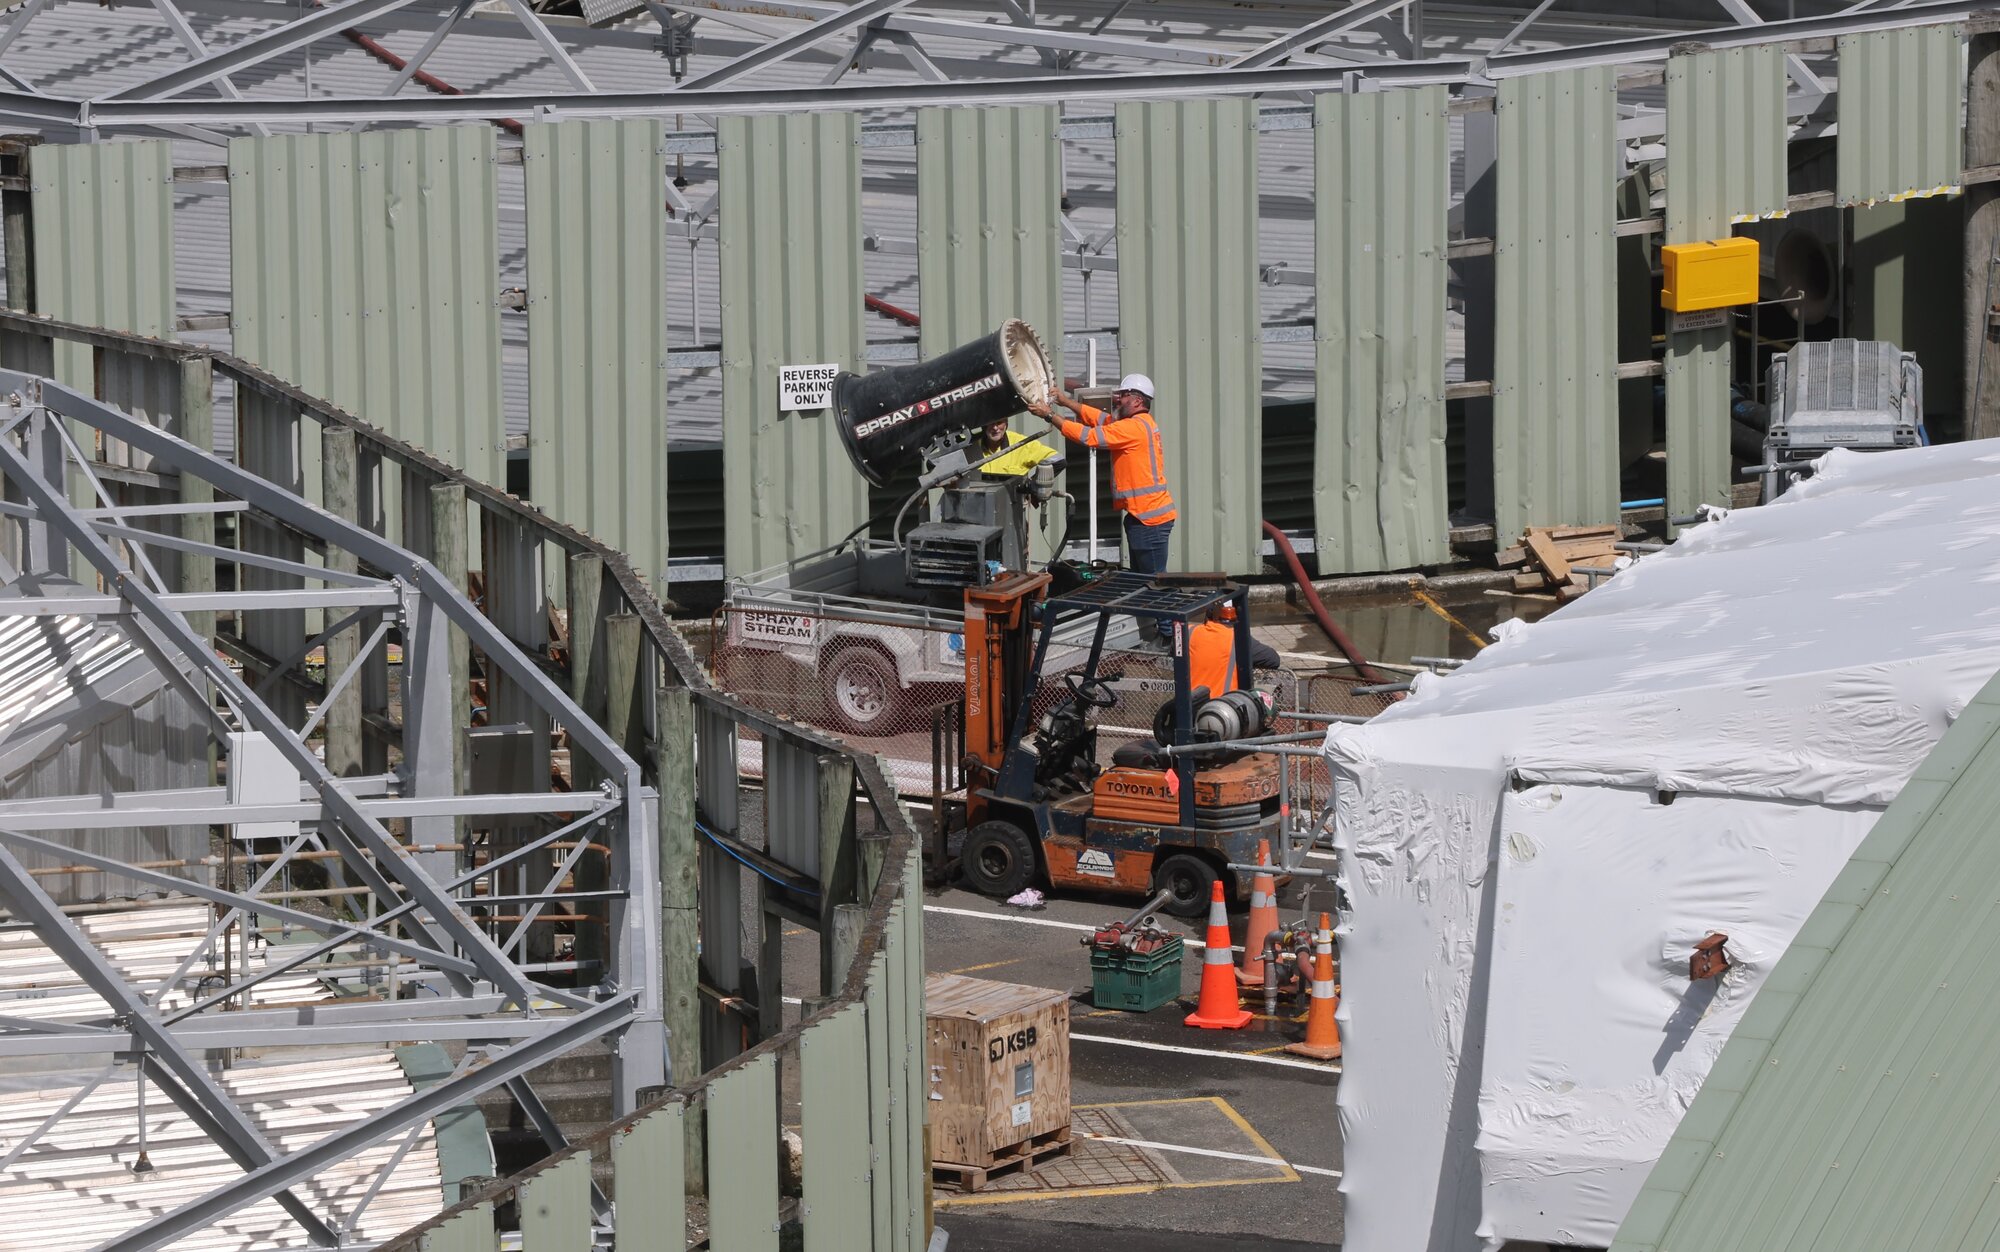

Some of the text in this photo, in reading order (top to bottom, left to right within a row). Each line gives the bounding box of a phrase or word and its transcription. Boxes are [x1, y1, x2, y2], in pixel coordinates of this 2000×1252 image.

[783, 369, 835, 381] REVERSE
[784, 381, 833, 393] PARKING
[794, 393, 824, 405] ONLY
[855, 373, 1003, 437] SPRAY STREAM
[744, 611, 798, 626] SPRAY
[744, 621, 811, 638] STREAM
[969, 656, 981, 717] TOYOTA
[1106, 782, 1155, 796] TOYOTA
[1246, 775, 1281, 800] TOY
[1007, 1026, 1037, 1054] KSB
